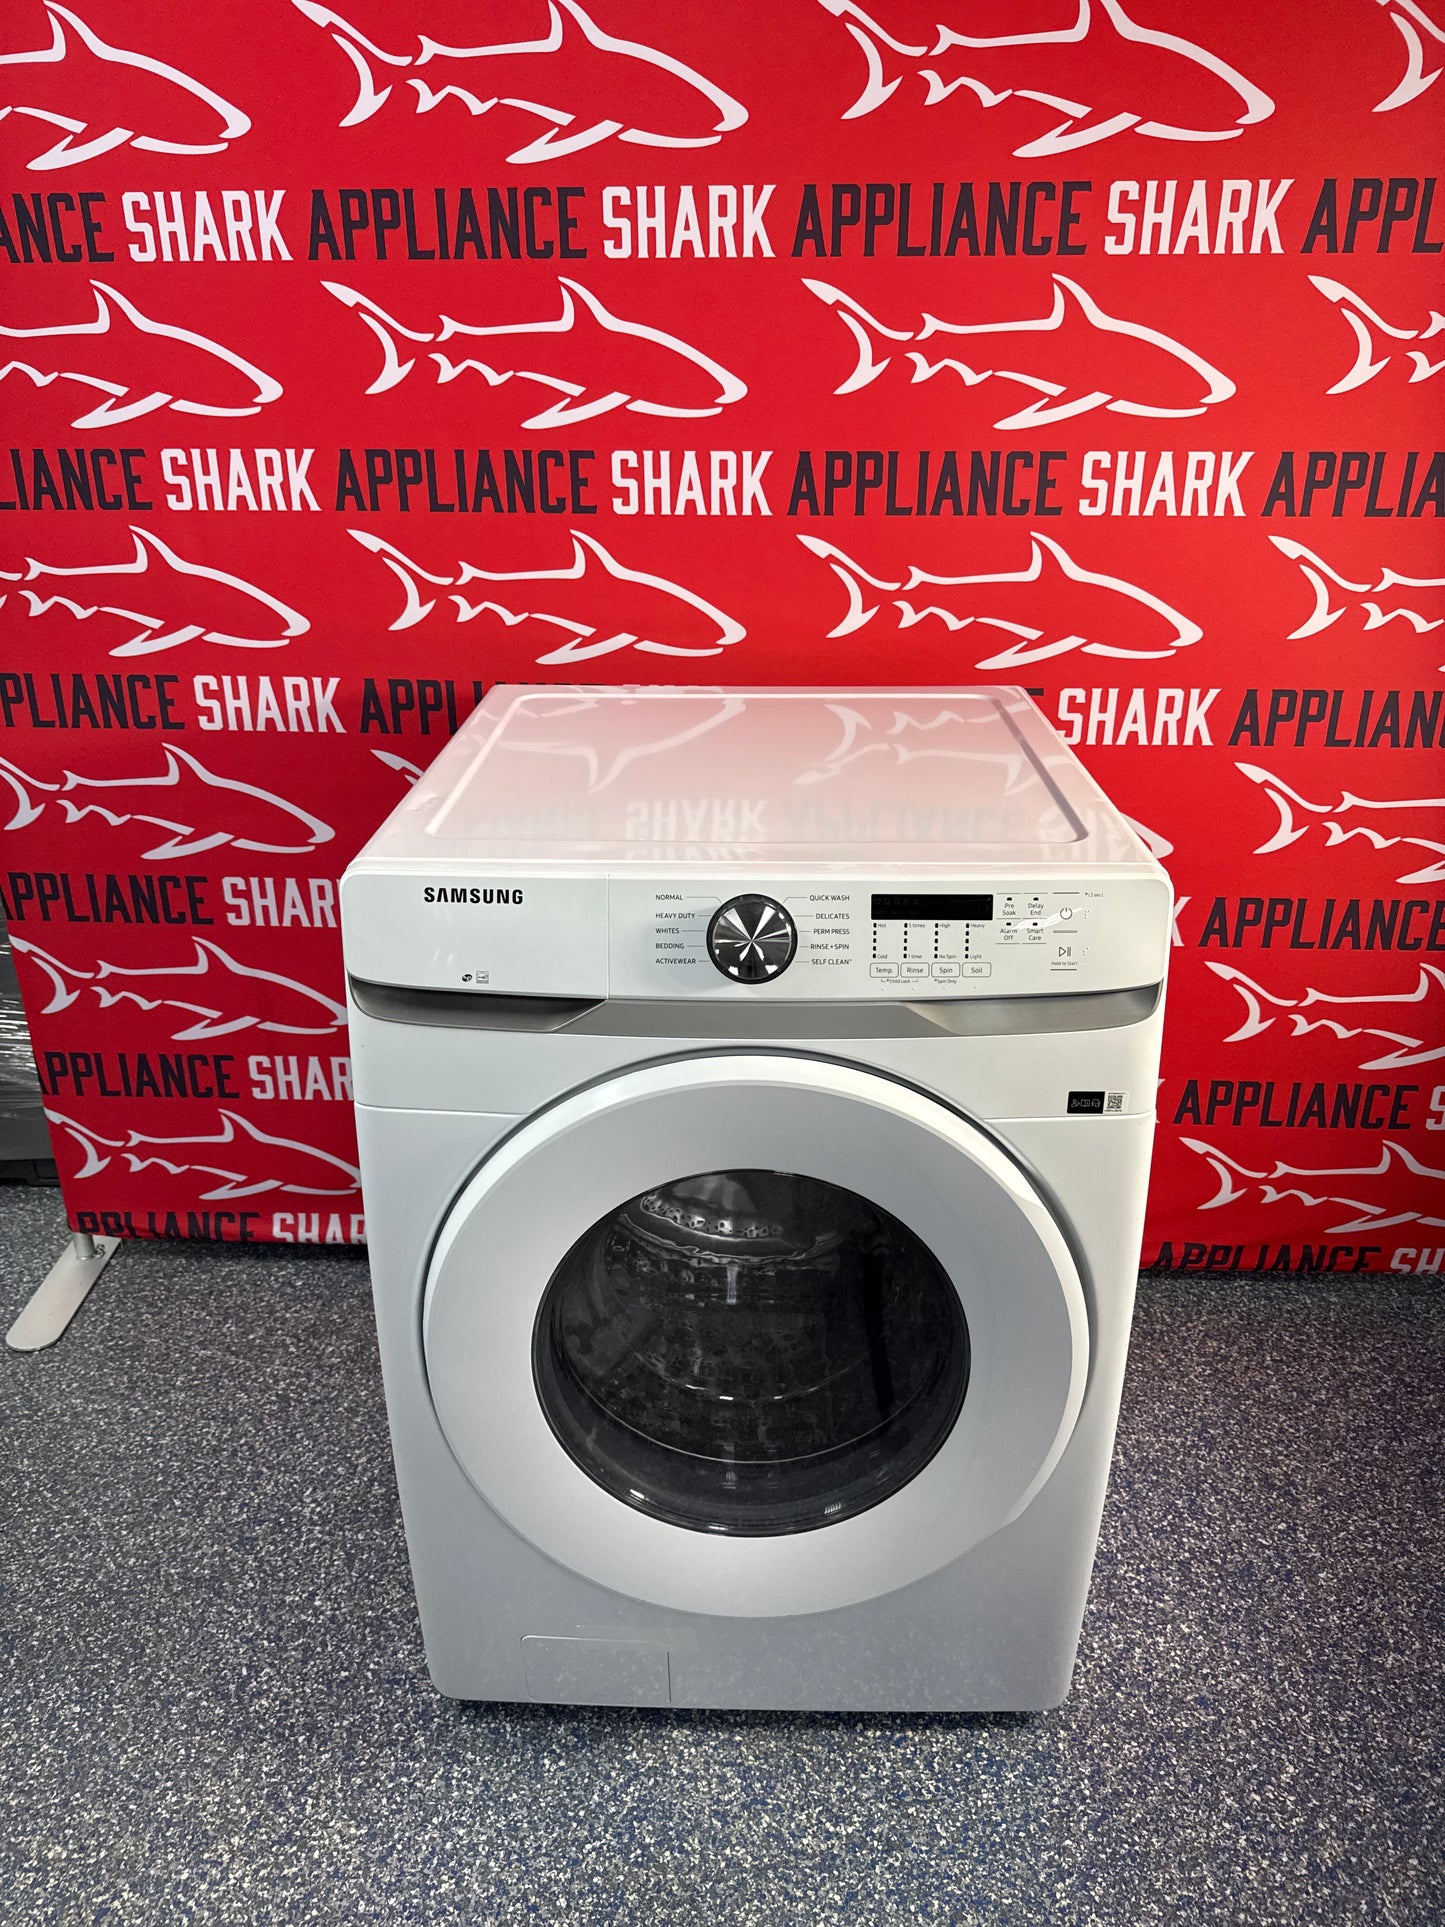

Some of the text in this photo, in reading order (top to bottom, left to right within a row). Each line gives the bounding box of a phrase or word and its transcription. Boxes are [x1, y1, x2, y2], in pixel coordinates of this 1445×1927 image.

[121, 189, 293, 262] SHARK
[308, 186, 587, 260] APPLIANCE
[602, 184, 775, 259] SHARK
[791, 180, 1092, 257] APPLIANCE
[1104, 179, 1294, 255] SHARK
[1300, 177, 1443, 254] APPL
[0, 448, 1445, 517] IANCE SHARK APPLIANCE SHARK APPLIANCE SHARK APPLIA
[193, 674, 346, 733] SHARK
[1056, 687, 1445, 749] SHARK APPLIAN
[424, 886, 523, 905] SAMSUNG
[655, 893, 684, 901] NORMAL
[809, 894, 850, 902] QUICK WASH
[222, 876, 341, 928] SHAR
[655, 912, 696, 920] HEAVY DUTY
[815, 912, 850, 920] DELICATES
[655, 927, 680, 935] WHITES
[813, 928, 850, 936] PERM PRESS
[655, 942, 685, 950] BEDDING
[810, 943, 829, 951] RINSE
[835, 943, 850, 951] SPIN
[655, 957, 697, 965] ACTIVEWEAR
[811, 958, 827, 966] SELF
[939, 967, 953, 975] Spin
[37, 1051, 240, 1098] PPLIANCE
[1172, 1079, 1420, 1130] APPLIANCE
